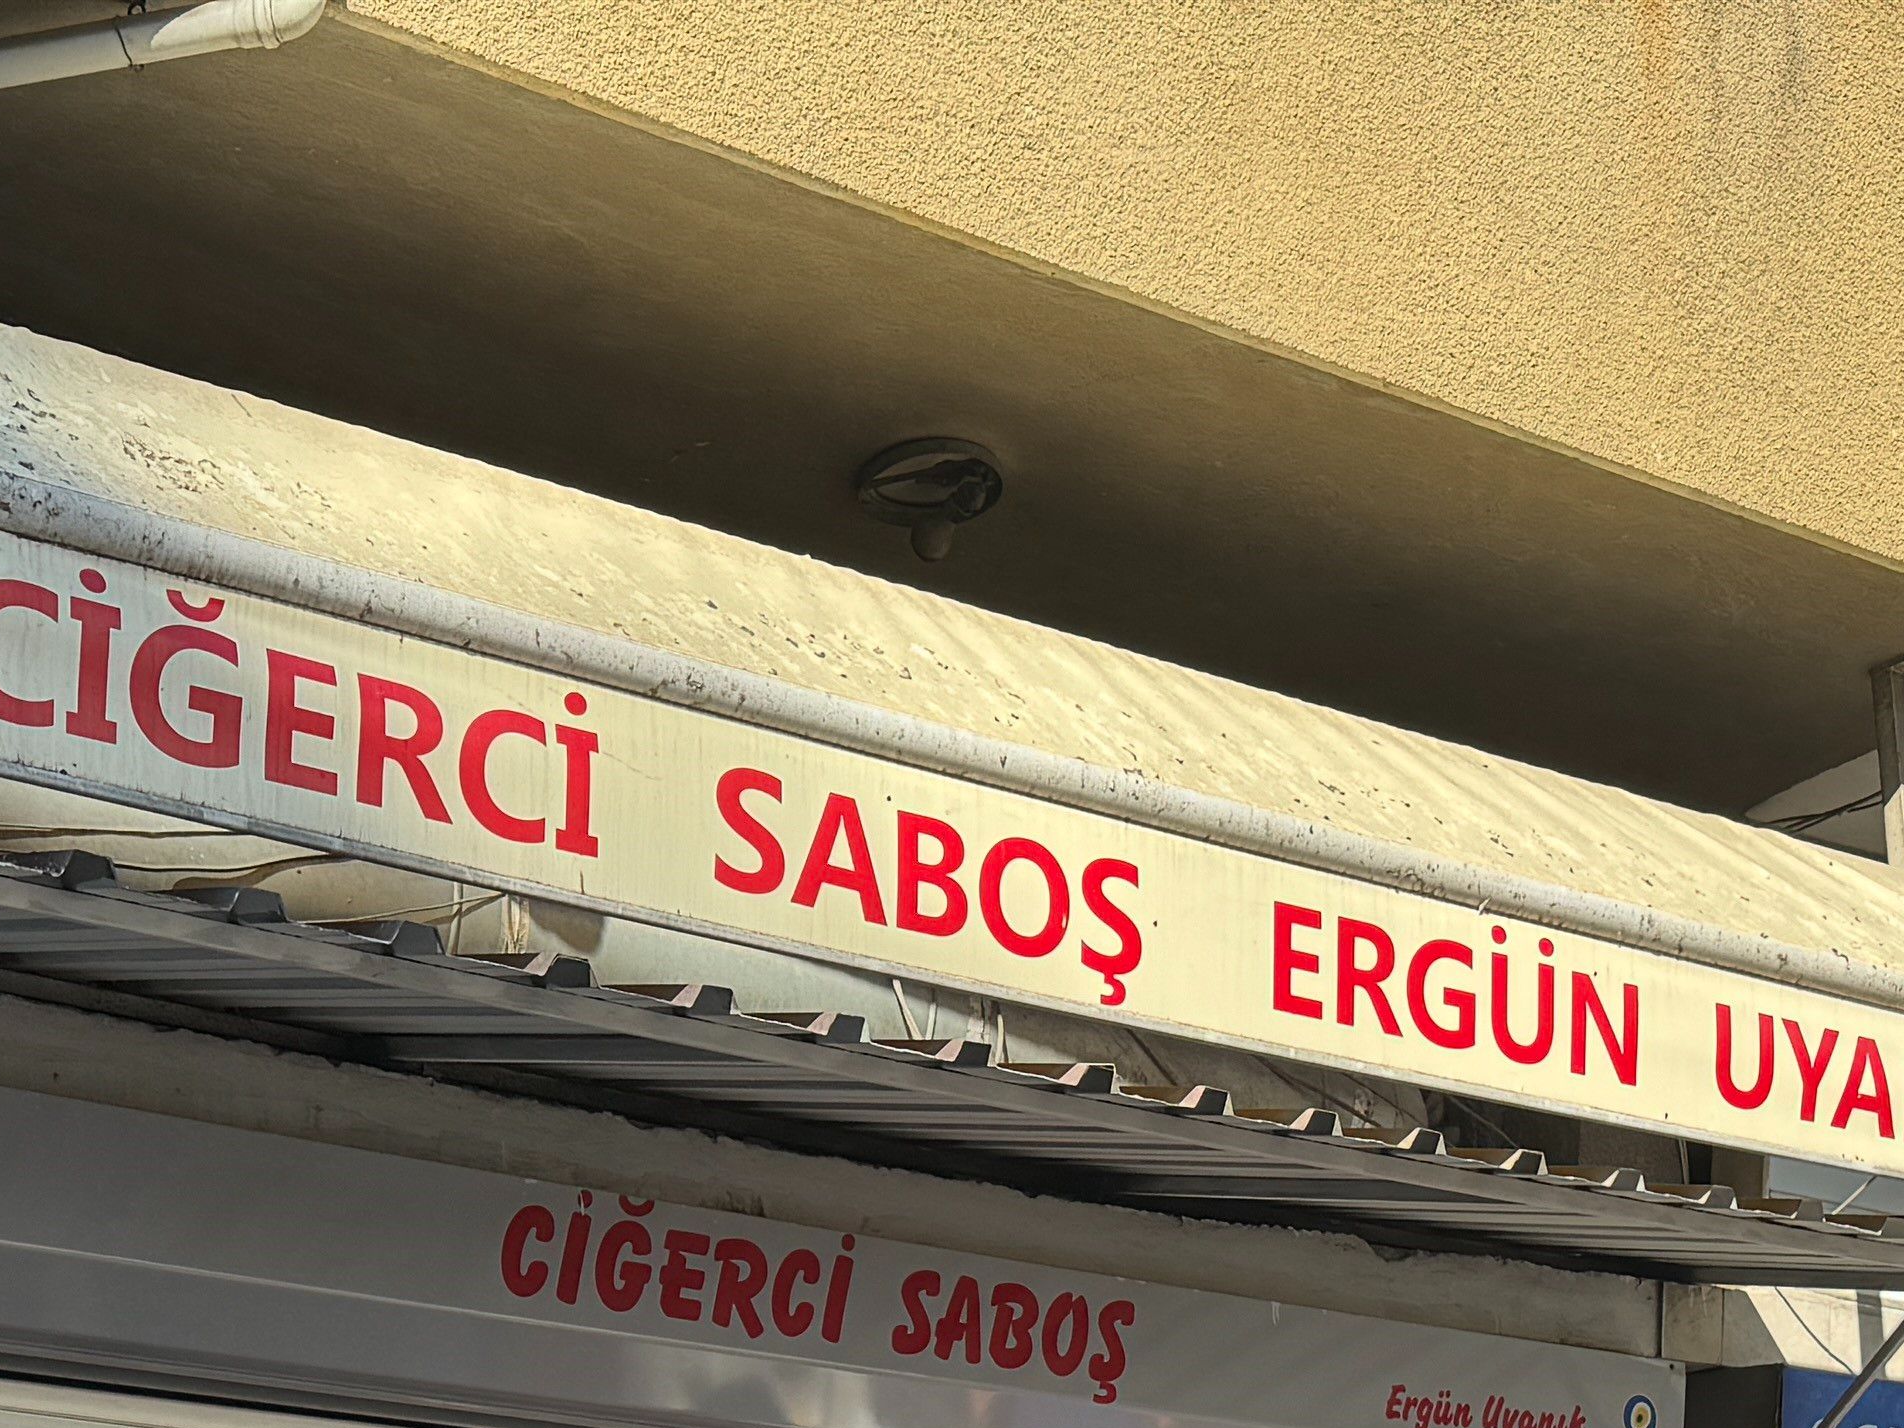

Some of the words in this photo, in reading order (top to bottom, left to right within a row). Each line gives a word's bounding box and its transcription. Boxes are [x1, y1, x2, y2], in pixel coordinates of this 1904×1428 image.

[714, 768, 1144, 1005] SABOŞ
[1272, 902, 1638, 1086] ERGÜN
[502, 1189, 854, 1344] CİĞERCİ
[893, 1269, 1135, 1404] SABOŞ
